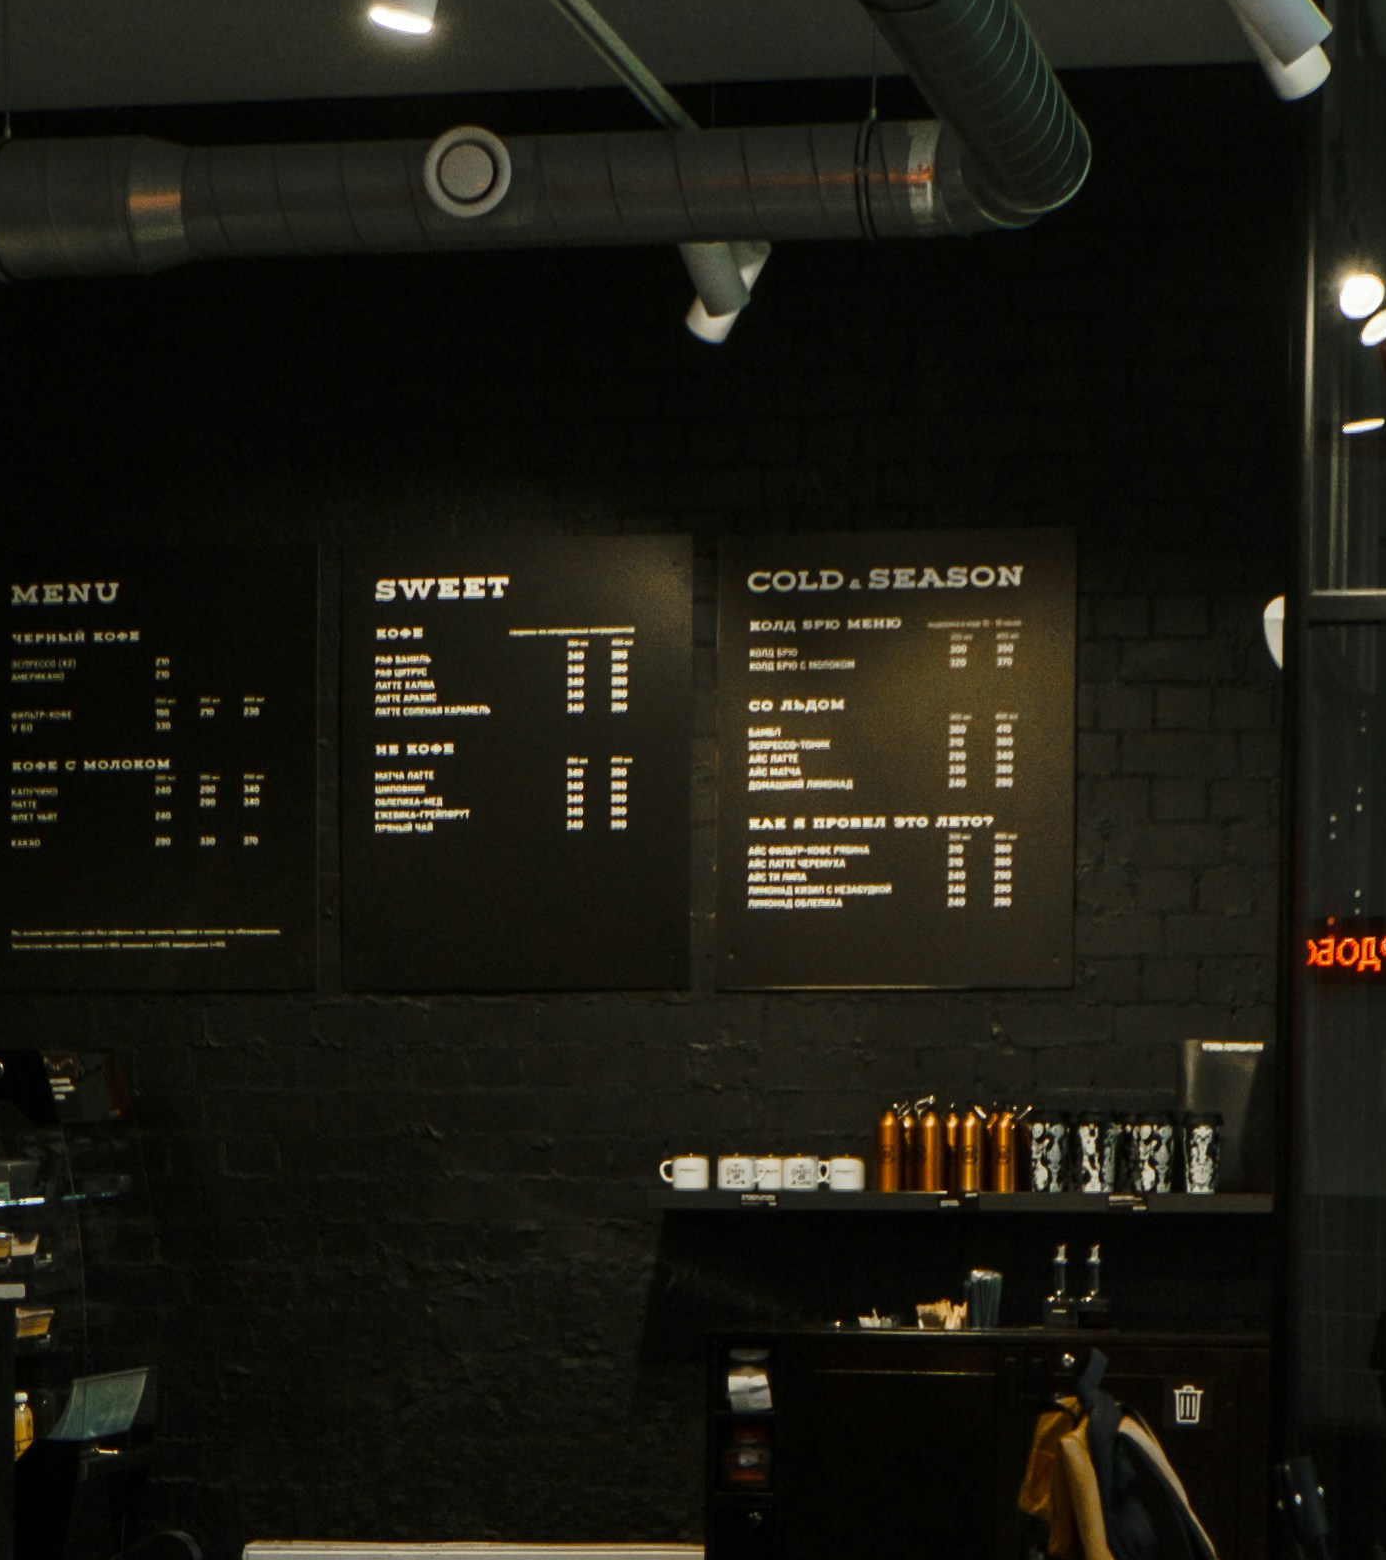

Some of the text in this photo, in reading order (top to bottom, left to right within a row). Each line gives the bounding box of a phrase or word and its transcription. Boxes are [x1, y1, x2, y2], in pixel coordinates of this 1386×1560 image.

[748, 570, 843, 592] COLD
[869, 566, 1023, 589] SEASON
[12, 583, 119, 604] MENU
[375, 576, 509, 601] SWEET
[749, 620, 797, 633] КОЛД
[847, 616, 903, 630] МЕНЮ
[11, 630, 140, 644] ЧЕРНЫЙ КОФЕ
[375, 627, 424, 639] КОФЕ
[748, 647, 775, 658] КОЛД
[748, 661, 775, 672] КОЛД
[748, 699, 844, 713] СО ЛЬДОМ
[375, 743, 455, 756] НЕ КОФЕ
[12, 760, 58, 771] КОФЕ
[748, 815, 994, 831] КАК Я ПРОВЕЛ ЭТО ЛЕТО?
